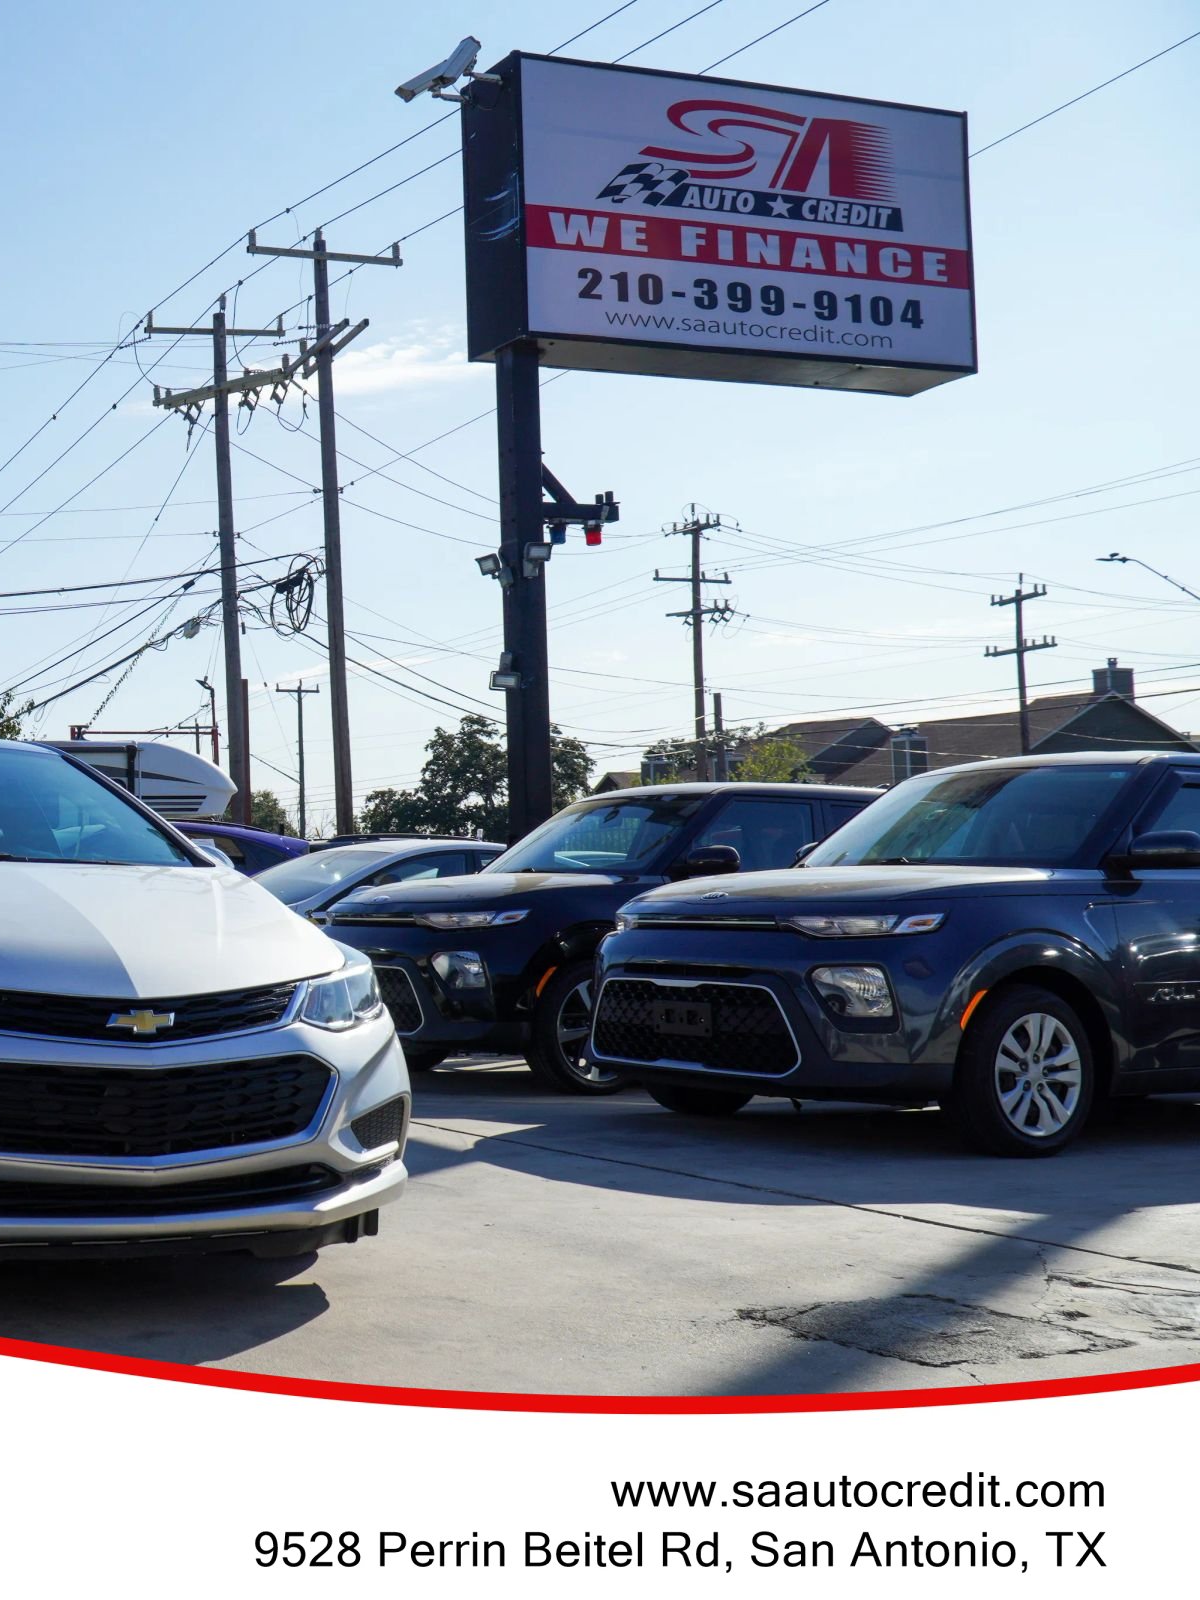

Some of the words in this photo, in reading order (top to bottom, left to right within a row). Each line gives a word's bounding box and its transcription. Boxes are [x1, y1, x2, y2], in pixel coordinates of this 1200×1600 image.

[638, 99, 897, 203] SA
[682, 186, 755, 214] AUTO
[801, 199, 892, 229] CREDIT
[549, 211, 649, 253] WE
[681, 225, 949, 282] FINANCE
[577, 267, 925, 329] 210-399-9104
[605, 310, 894, 348] www.saautocredit.com
